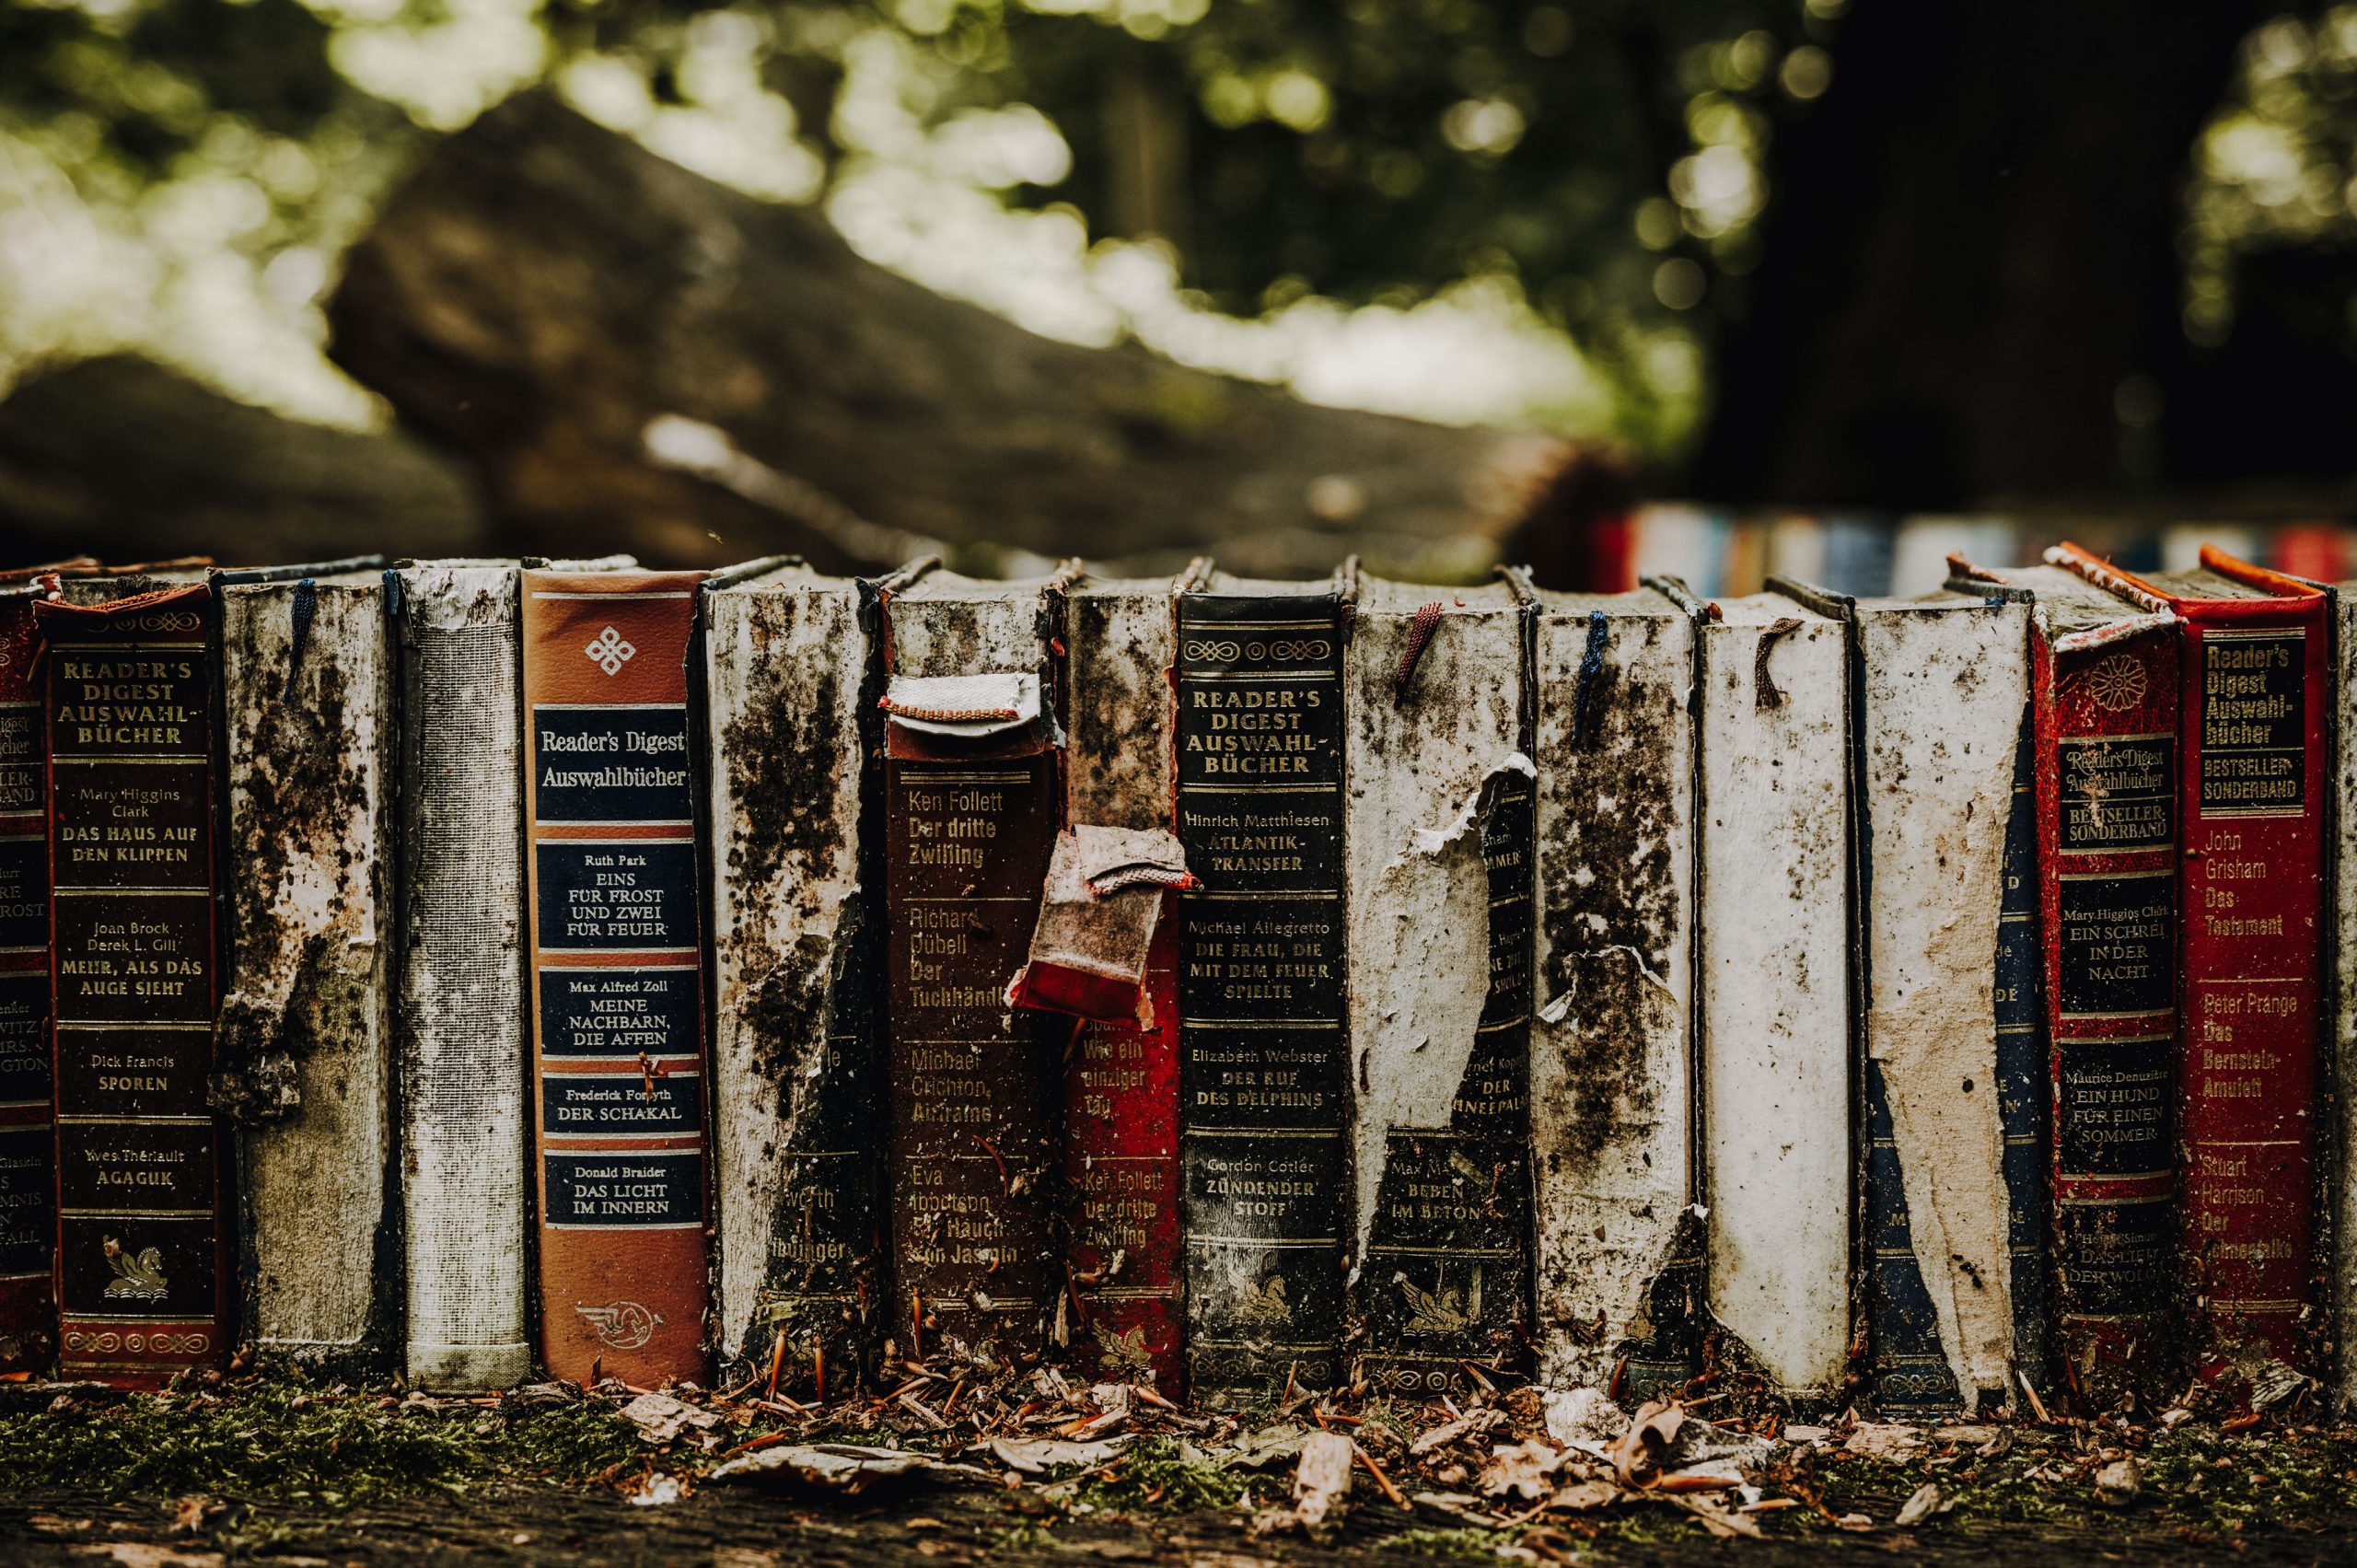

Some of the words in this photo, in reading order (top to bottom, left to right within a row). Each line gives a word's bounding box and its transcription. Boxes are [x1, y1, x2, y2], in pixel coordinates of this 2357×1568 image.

[2207, 645, 2290, 668] Reader's
[64, 663, 192, 679] READER'S
[84, 684, 173, 701] DIGEST
[2206, 670, 2267, 699] Digest
[1193, 691, 1320, 708] READER'S
[2205, 694, 2295, 720] Auswahl-
[58, 705, 201, 722] AUSWAHL-
[1212, 713, 1302, 729] DIGEST
[78, 724, 181, 744] BÜCHER
[2206, 721, 2273, 745] bücher
[541, 731, 619, 752] Reader's
[626, 731, 685, 755] Digest
[1186, 735, 1328, 751] AUSWAHL-
[1205, 753, 1309, 772] BÜCHER
[2122, 749, 2164, 771] Digest
[541, 767, 686, 787] Auswahlbücher
[80, 789, 117, 803] Mary
[124, 789, 180, 803] Higgins
[2203, 781, 2297, 800] SONDERBAND
[909, 791, 942, 811] Ken
[950, 791, 1003, 811] Follett
[112, 806, 149, 818] Clark
[909, 818, 942, 838] Der
[948, 818, 996, 838] dritte
[1187, 813, 1238, 827] Hinrich
[1246, 813, 1329, 828] Matthiesen
[63, 827, 99, 841] DAS
[108, 827, 156, 841] HAUS
[164, 828, 197, 841] AUF
[2069, 821, 2166, 841] SONDERBAND
[1209, 835, 1306, 850] ATLANTIK-
[2205, 830, 2242, 851] John
[73, 848, 109, 862] DEN
[117, 848, 188, 862] KLIPPEN
[585, 854, 614, 866] Ruth
[619, 854, 646, 866] Park
[909, 843, 984, 868] Zwilling
[1213, 857, 1302, 871] TRANSFER
[2205, 857, 2267, 879] Grisham
[597, 873, 635, 886] EINS
[568, 889, 603, 903] FÜR
[609, 889, 664, 903] FROST
[2205, 887, 2235, 908] Das
[572, 907, 610, 919] UND
[617, 906, 661, 919] ZWEI
[2063, 910, 2095, 922] Mary
[2097, 909, 2139, 922] Higgins
[2142, 906, 2168, 917] Clark
[94, 923, 124, 936] Joan
[131, 923, 168, 934] Brock
[567, 923, 601, 936] FÜR
[608, 923, 667, 936] FEUER
[1190, 921, 1246, 935] Michael
[1253, 920, 1329, 937] Allegretto
[2071, 927, 2101, 941] EIN
[2105, 923, 2165, 940] SCHREI
[2205, 914, 2282, 936] Testament
[88, 939, 128, 951] Derek
[135, 939, 147, 951] L.
[153, 939, 176, 951] Gill
[1196, 943, 1225, 957] DIE
[1232, 943, 1285, 958] FRAU,
[1293, 943, 1322, 957] DIE
[2090, 947, 2107, 960] IN
[2113, 945, 2148, 959] DER
[125, 960, 158, 974] ALS
[167, 960, 202, 975] DAS
[911, 959, 943, 981] Der
[1190, 963, 1221, 978] MIT
[1229, 963, 1267, 978] DEM
[1276, 963, 1329, 978] FEUER
[2089, 965, 2150, 981] NACHT
[80, 981, 127, 995] AUGE
[136, 981, 183, 995] SIEHT
[570, 981, 596, 993] Max
[600, 981, 639, 993] Alfred
[643, 981, 668, 992] Zoll
[1225, 985, 1292, 999] SPIELTE
[590, 999, 648, 1012] MEINE
[2204, 993, 2243, 1014] Peter
[2247, 993, 2297, 1017] Prange
[569, 1016, 670, 1029] NACHBARN,
[574, 1033, 604, 1046] DIE
[611, 1032, 667, 1046] AFFEN
[2203, 1021, 2233, 1042] Das
[1119, 1039, 1143, 1059] ein
[1192, 1048, 1259, 1062] Elizabeth
[1266, 1049, 1328, 1063] Webster
[92, 1055, 121, 1068] Dick
[127, 1055, 174, 1068] Francis
[2203, 1049, 2281, 1070] Bernstein-
[99, 1076, 168, 1090] SPOREN
[1083, 1066, 1145, 1091] einziger
[1222, 1072, 1256, 1086] DER
[1265, 1072, 1297, 1086] RUF
[2066, 1071, 2112, 1084] Maurice
[566, 1089, 621, 1100] Frederick
[626, 1089, 672, 1101] Foryth
[1482, 1079, 1511, 1095] DER
[2076, 1090, 2107, 1103] EIN
[2111, 1087, 2160, 1102] HUND
[2202, 1076, 2262, 1098] Amulett
[1197, 1092, 1229, 1105] DES
[1237, 1092, 1323, 1106] DELPHINS
[558, 1108, 594, 1121] DER
[600, 1107, 681, 1121] SCHAKAL
[2074, 1109, 2108, 1123] FÜR
[2114, 1106, 2163, 1122] EINEN
[2082, 1128, 2156, 1143] SOMMER
[85, 1150, 118, 1162] Yves
[122, 1149, 184, 1162] Thériault
[575, 1167, 618, 1178] Donald
[622, 1167, 666, 1178] Braider
[1208, 1159, 1262, 1172] Gordon
[1269, 1160, 1314, 1173] Cotler
[2201, 1155, 2247, 1177] Stuart
[97, 1171, 173, 1185] AGAGUK
[912, 1165, 943, 1186] Eva
[1086, 1170, 1111, 1191] Ken
[1118, 1170, 1162, 1191] Follett
[575, 1185, 607, 1198] DAS
[615, 1184, 668, 1198] LICHT
[1207, 1178, 1315, 1196] ZÜNDENDER
[2201, 1183, 2264, 1204] Harrison
[574, 1202, 595, 1214] IM
[602, 1201, 669, 1214] INNERN
[1118, 1198, 1156, 1218] dritte
[1234, 1202, 1286, 1216] STOFF
[1392, 1203, 1413, 1218] IM
[2201, 1212, 2229, 1231] Der
[2069, 1270, 2107, 1284] DER
